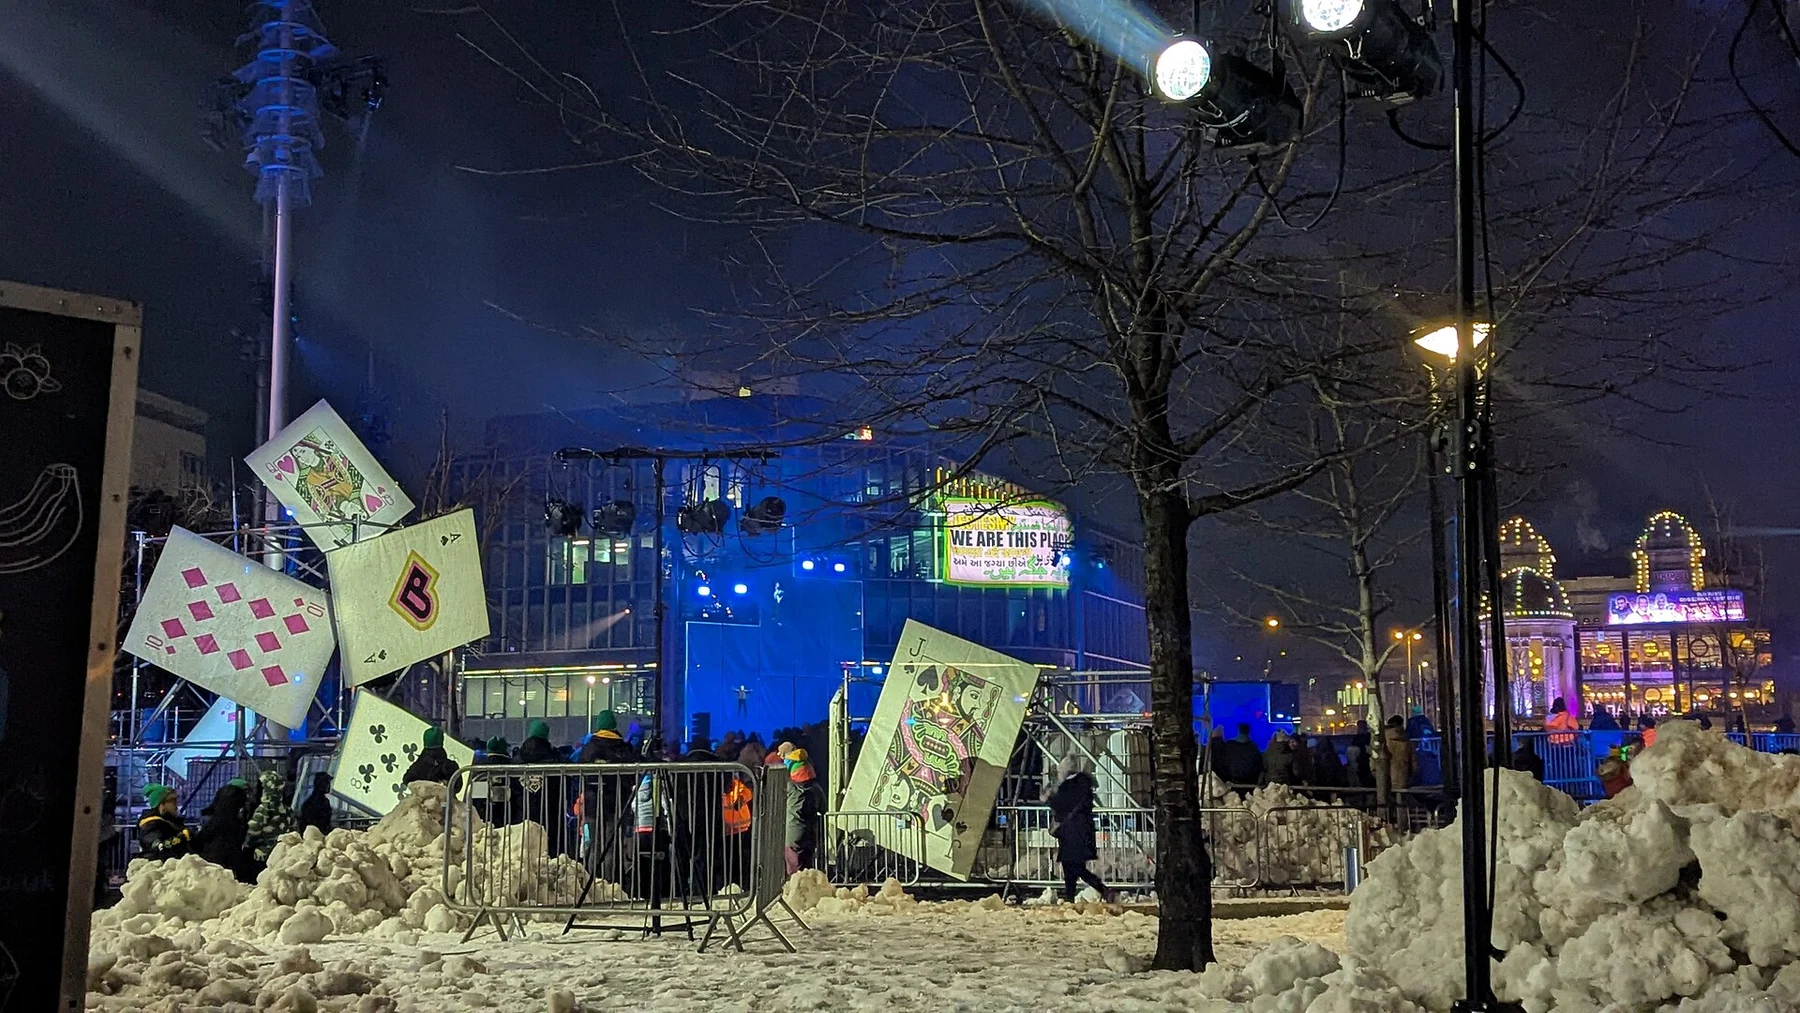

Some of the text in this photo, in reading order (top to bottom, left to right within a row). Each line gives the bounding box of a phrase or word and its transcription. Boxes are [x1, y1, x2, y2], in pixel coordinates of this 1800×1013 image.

[950, 530, 973, 546] WE
[976, 531, 1004, 547] ARE
[1007, 531, 1037, 548] THIS
[306, 602, 326, 618] 10
[145, 634, 164, 651] 10
[909, 637, 927, 657] J
[350, 777, 362, 790] 8
